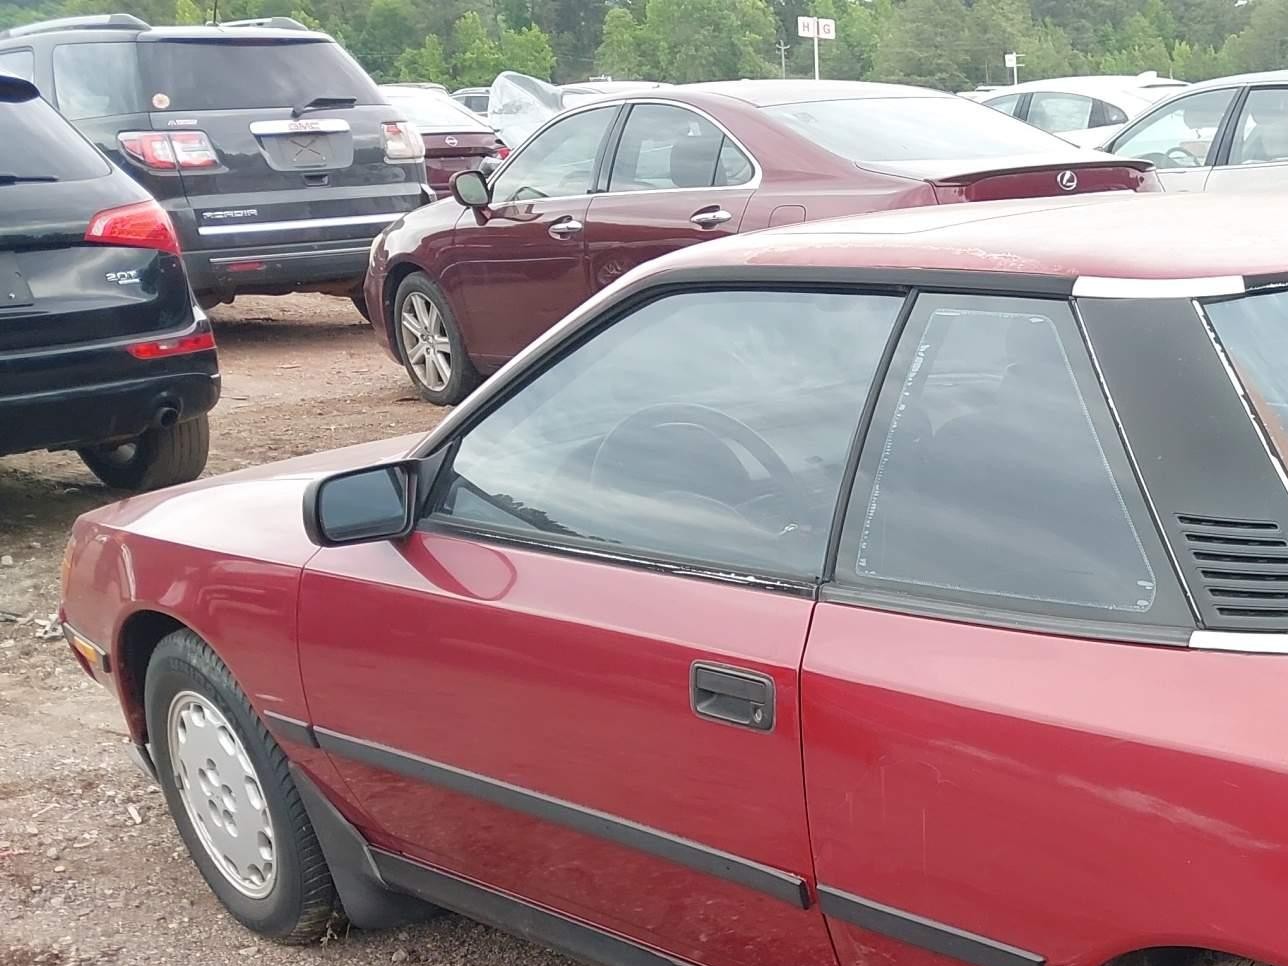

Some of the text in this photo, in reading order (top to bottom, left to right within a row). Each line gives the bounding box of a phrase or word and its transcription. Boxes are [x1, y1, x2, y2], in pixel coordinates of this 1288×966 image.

[802, 22, 810, 32] H
[823, 24, 831, 34] G
[287, 121, 321, 131] GMC
